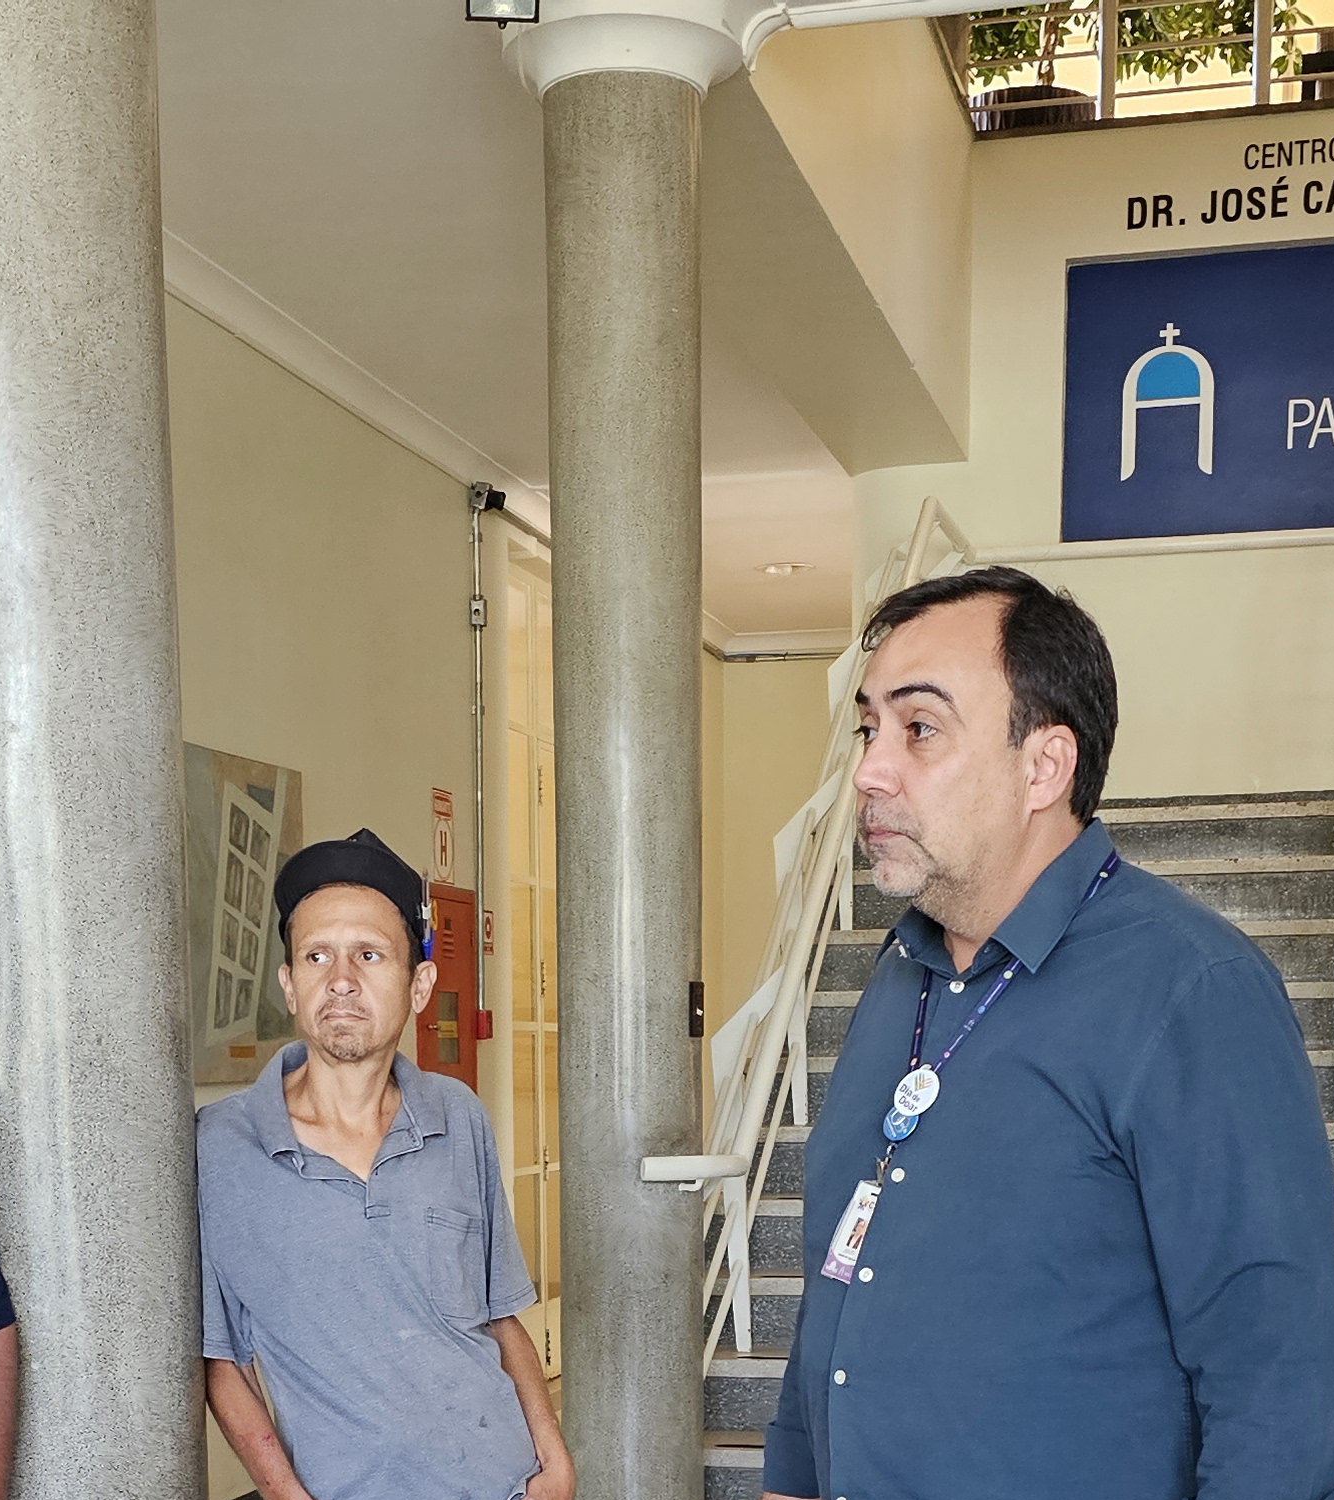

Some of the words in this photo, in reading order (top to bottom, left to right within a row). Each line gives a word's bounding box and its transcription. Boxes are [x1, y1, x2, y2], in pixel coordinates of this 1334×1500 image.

[1126, 194, 1186, 231] DR.
[1200, 175, 1290, 225] JOSÉ
[439, 829, 448, 867] H
[898, 1095, 919, 1113] Doar
[899, 1083, 913, 1098] Dia
